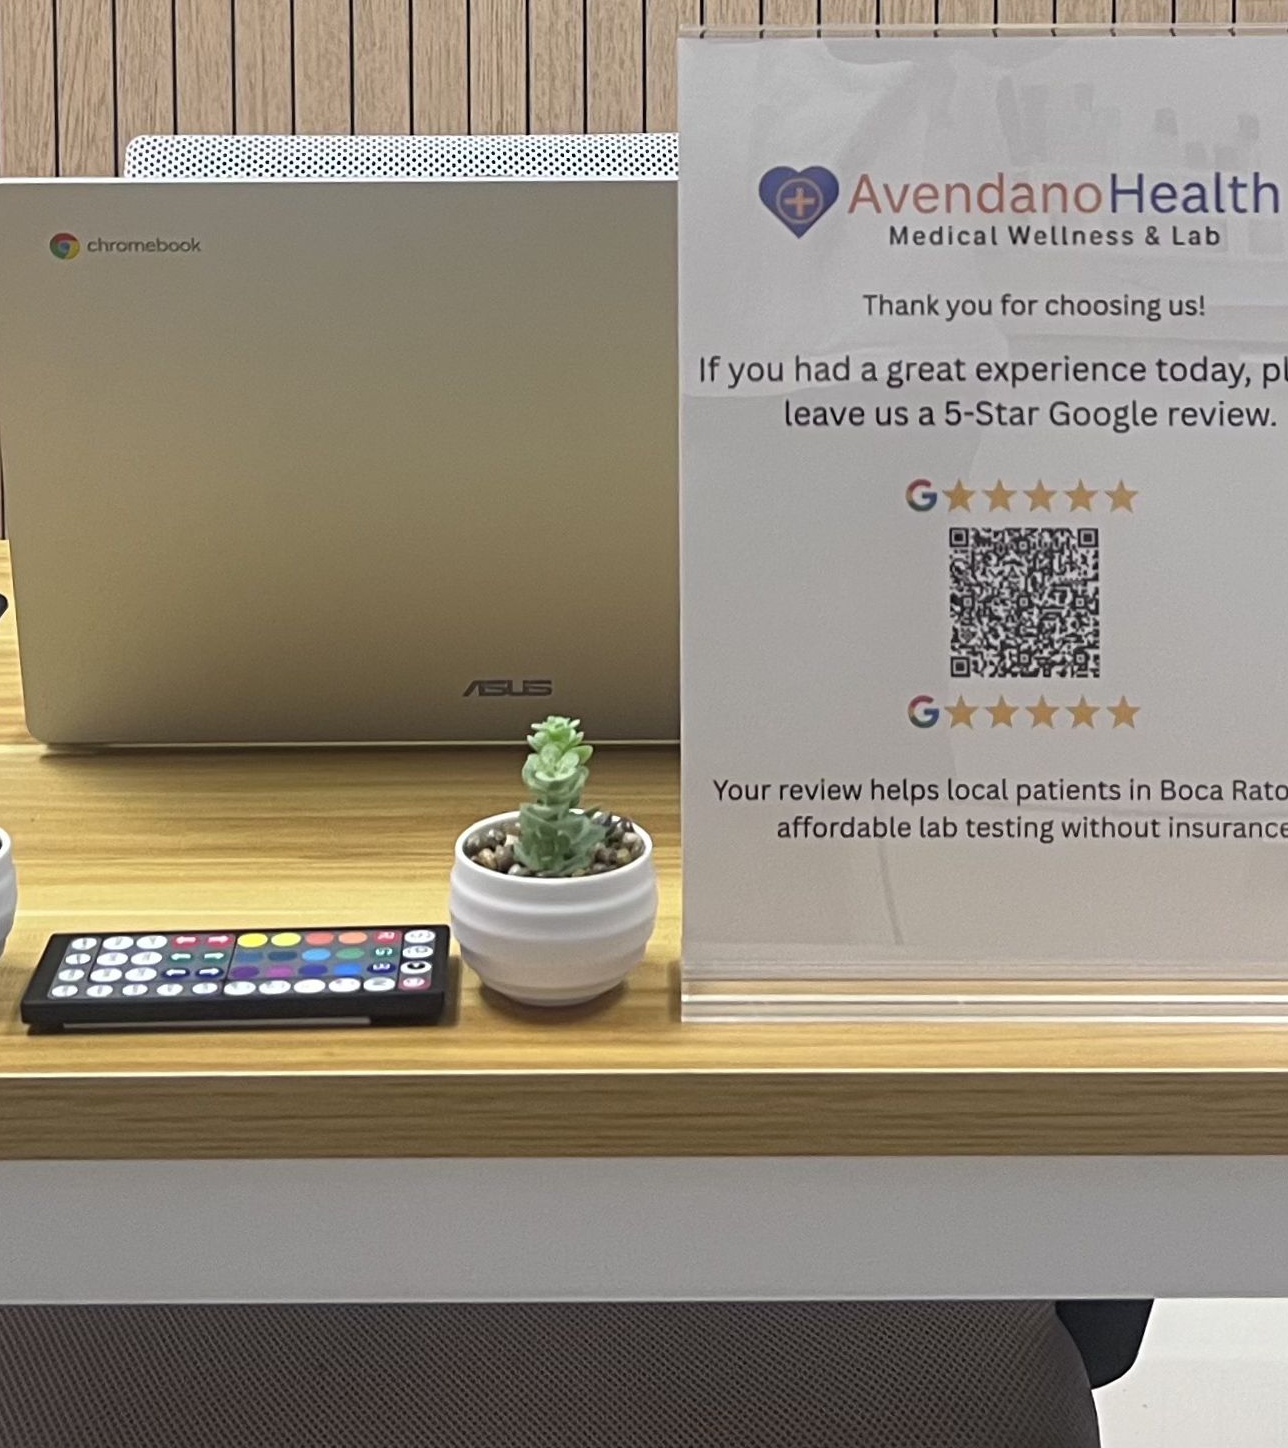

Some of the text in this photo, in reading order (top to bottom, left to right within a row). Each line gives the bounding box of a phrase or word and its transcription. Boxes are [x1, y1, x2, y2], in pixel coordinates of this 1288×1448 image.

[87, 237, 201, 252] chromebook
[890, 225, 1220, 245] Medical Wellness & Lab
[863, 293, 1205, 322] Thank you for choosing us!
[700, 356, 721, 382] If
[728, 362, 783, 389] you
[795, 355, 850, 382] had
[861, 362, 878, 382] a
[886, 359, 966, 389] great
[976, 355, 1146, 388] experience
[1155, 356, 1251, 389] today,
[785, 400, 1276, 433] leave us a 5-Star Google review.
[463, 680, 552, 697] ASUS
[713, 780, 771, 801] Your
[780, 778, 862, 801] review
[871, 778, 939, 806] helps
[948, 778, 1008, 801] local
[1017, 778, 1121, 806] patients
[1130, 778, 1150, 800] in
[1161, 779, 1223, 801] Boca
[778, 816, 911, 838] affordable
[920, 816, 957, 838] lab
[966, 816, 1054, 844] testing
[1061, 816, 1160, 838] without
